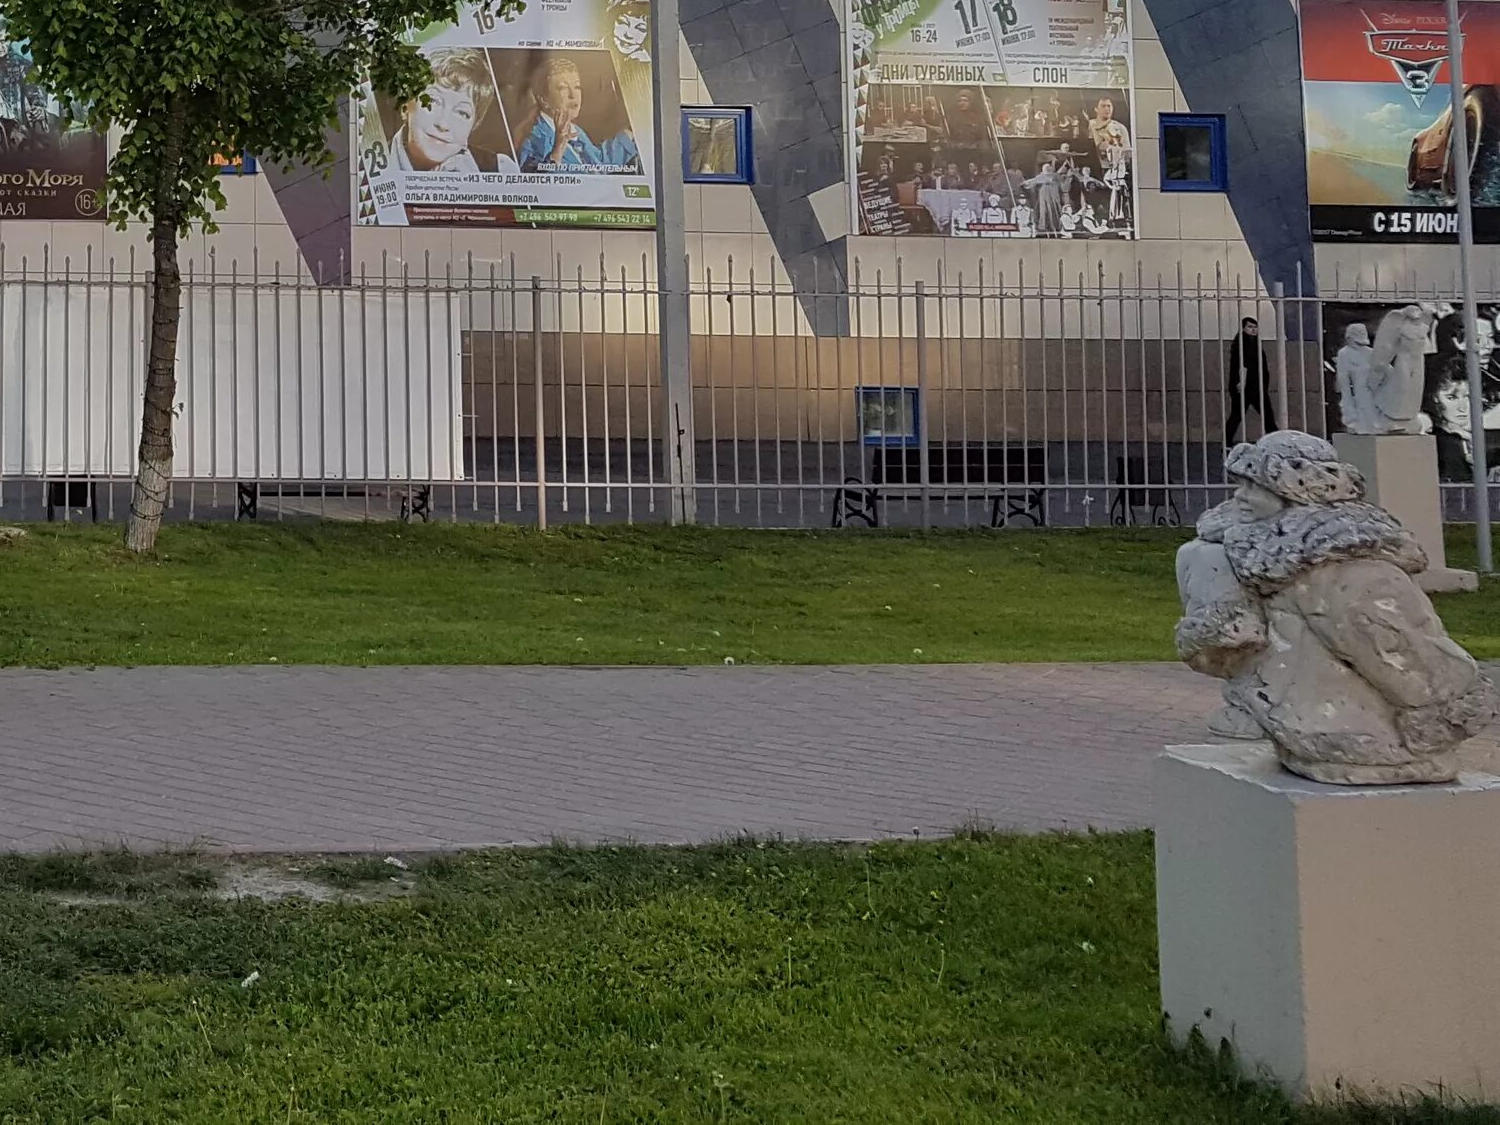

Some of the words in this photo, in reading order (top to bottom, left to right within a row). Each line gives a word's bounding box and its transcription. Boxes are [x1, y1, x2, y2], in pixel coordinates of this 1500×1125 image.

[1416, 16, 1447, 25] PIXAR
[911, 29, 938, 43] 16-24
[881, 64, 909, 81] ДНИ
[913, 65, 985, 82] ТУРБИНЫХ
[1033, 67, 1067, 83] СЛОН
[1406, 70, 1429, 93] 3
[364, 141, 388, 179] 23
[537, 163, 555, 171] ВХОД
[482, 175, 503, 183] ЧЕГО
[505, 176, 551, 184] ДЕЛАЮТСЯ
[373, 180, 397, 194] ИЮНЯ
[405, 193, 430, 202] ОЛЬГА
[433, 193, 500, 203] ВЛАДИМИРОВНА
[502, 194, 539, 203] ВОЛКОВА
[1373, 211, 1386, 232] С
[1389, 212, 1411, 233] 15
[1415, 212, 1461, 233] ИЮН
